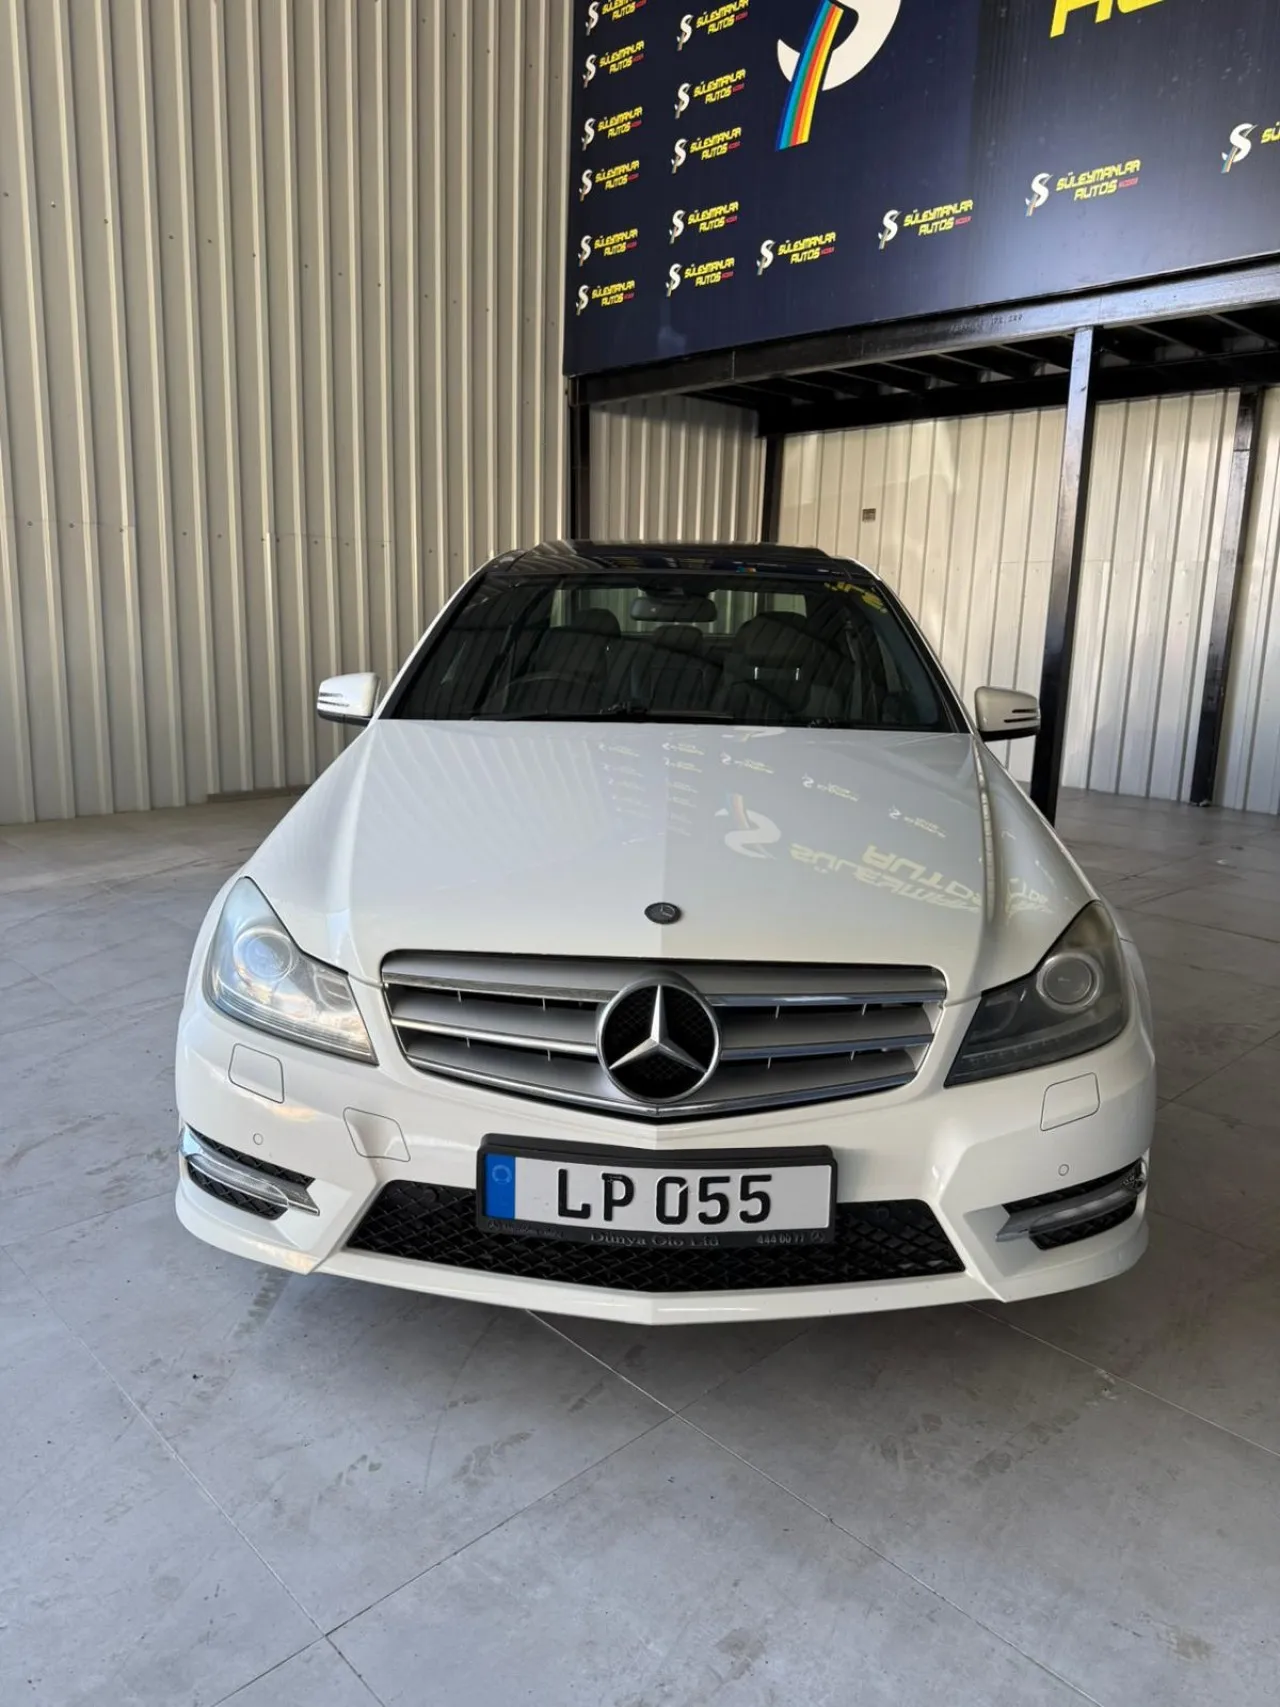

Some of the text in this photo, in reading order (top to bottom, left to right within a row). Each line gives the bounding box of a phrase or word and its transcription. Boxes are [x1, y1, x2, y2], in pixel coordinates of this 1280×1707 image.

[612, 6, 637, 21] AUTOS
[708, 14, 735, 34] AUTOS
[599, 40, 645, 68] SÜLEYMANLAR
[609, 56, 633, 74] AUTOS
[693, 68, 746, 98] SÜLEYMANLAR
[705, 86, 733, 104] AUTOS
[597, 106, 643, 132] SÜLEYMANLAR
[608, 122, 632, 139] AUTOS
[690, 126, 742, 153] SÜLEYMANLAR
[701, 142, 728, 160] AUTOS
[595, 160, 640, 183] SÜLEYMANLAR
[1056, 159, 1141, 191] SÜLEYMANLAR
[605, 174, 628, 190] AUTOS
[1074, 179, 1118, 201] AUTOS
[688, 201, 740, 225] SÜLEYMANLAR
[903, 199, 974, 227] SÜLEYMANLAR
[699, 215, 726, 232] AUTOS
[918, 217, 955, 236] AUTOS
[594, 228, 639, 249] SÜLEYMANLAR
[777, 231, 836, 256] SÜLEYMANLAR
[604, 243, 627, 256] AUTOS
[790, 247, 820, 264] AUTOS
[684, 257, 735, 279] SÜLEYMANLAR
[695, 271, 722, 287] AUTOS
[592, 280, 636, 299] SÜLEYMANLAR
[601, 292, 624, 307] AUTOS
[557, 1168, 773, 1225] LP 055
